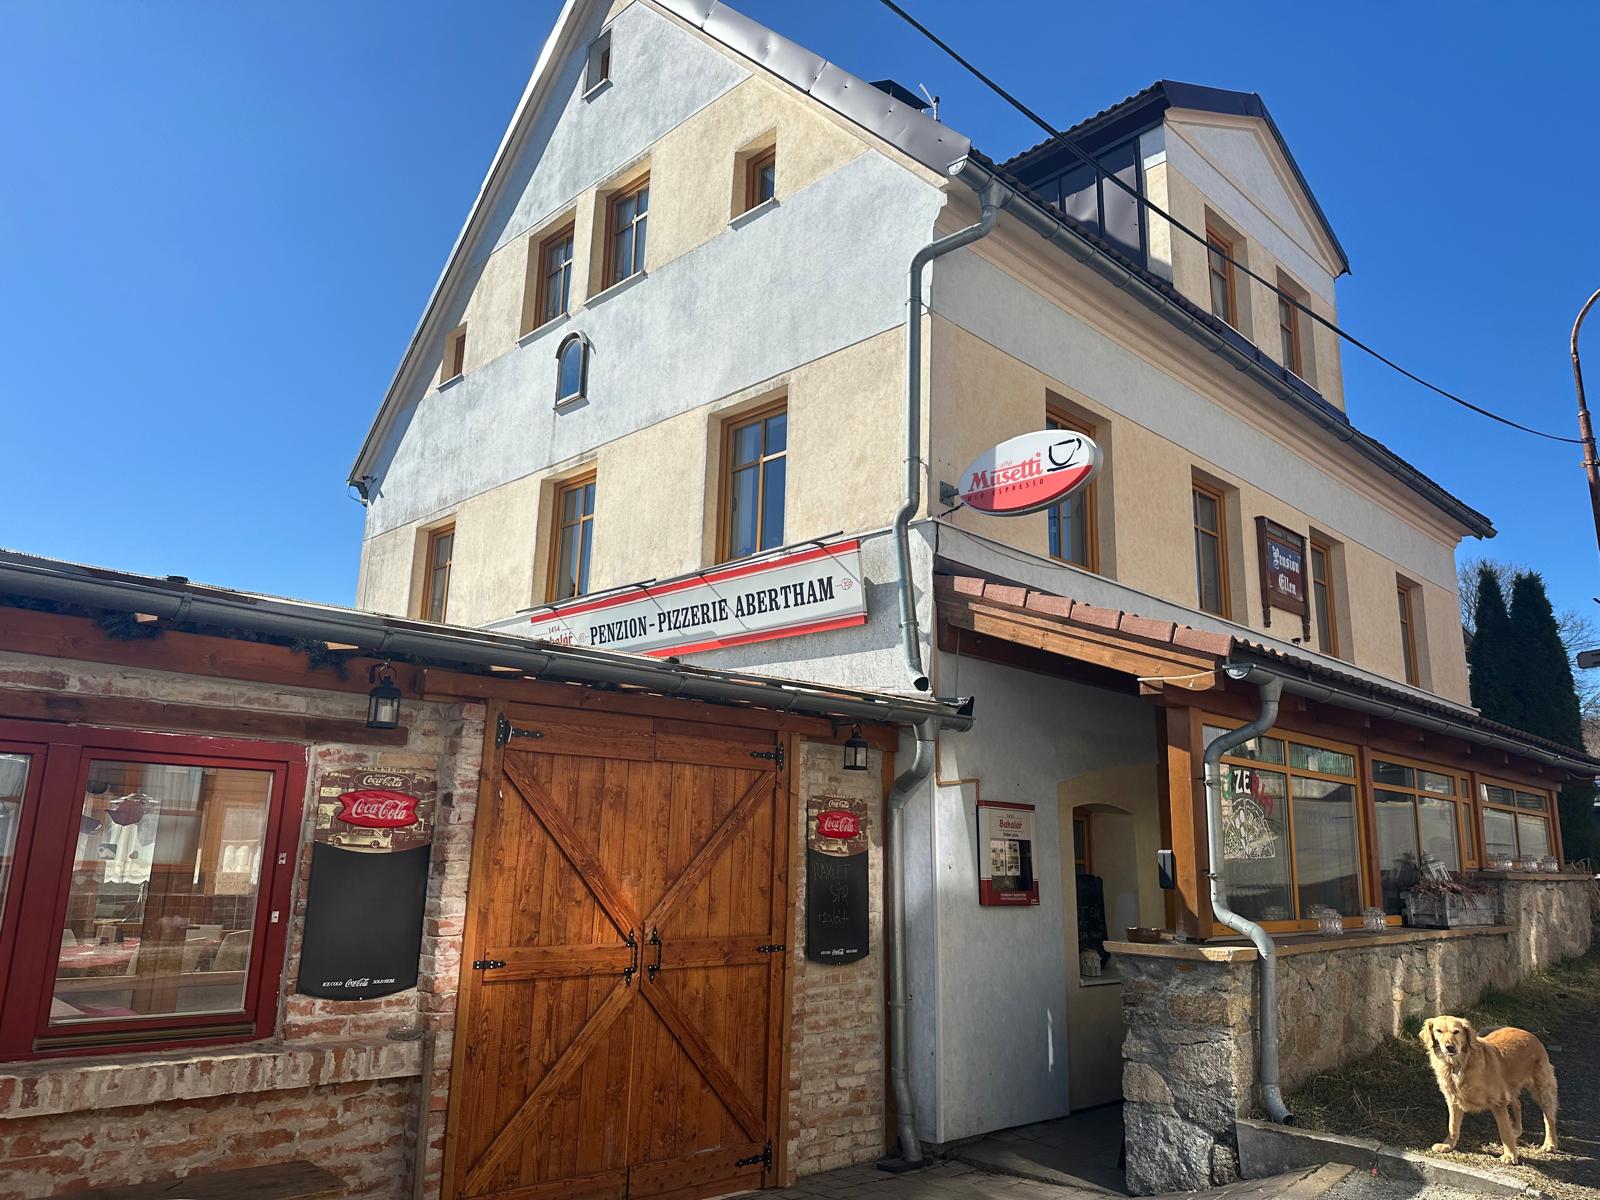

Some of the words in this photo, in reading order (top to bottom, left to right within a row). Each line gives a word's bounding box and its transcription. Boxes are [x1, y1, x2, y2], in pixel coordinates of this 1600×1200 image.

[968, 452, 1043, 493] Musetti
[992, 478, 1045, 497] ESPRESSO
[1271, 545, 1299, 574] Pension
[734, 577, 835, 618] ABERTHAM
[352, 798, 410, 821] Coca-Cola
[824, 816, 855, 833] Coca-Cola
